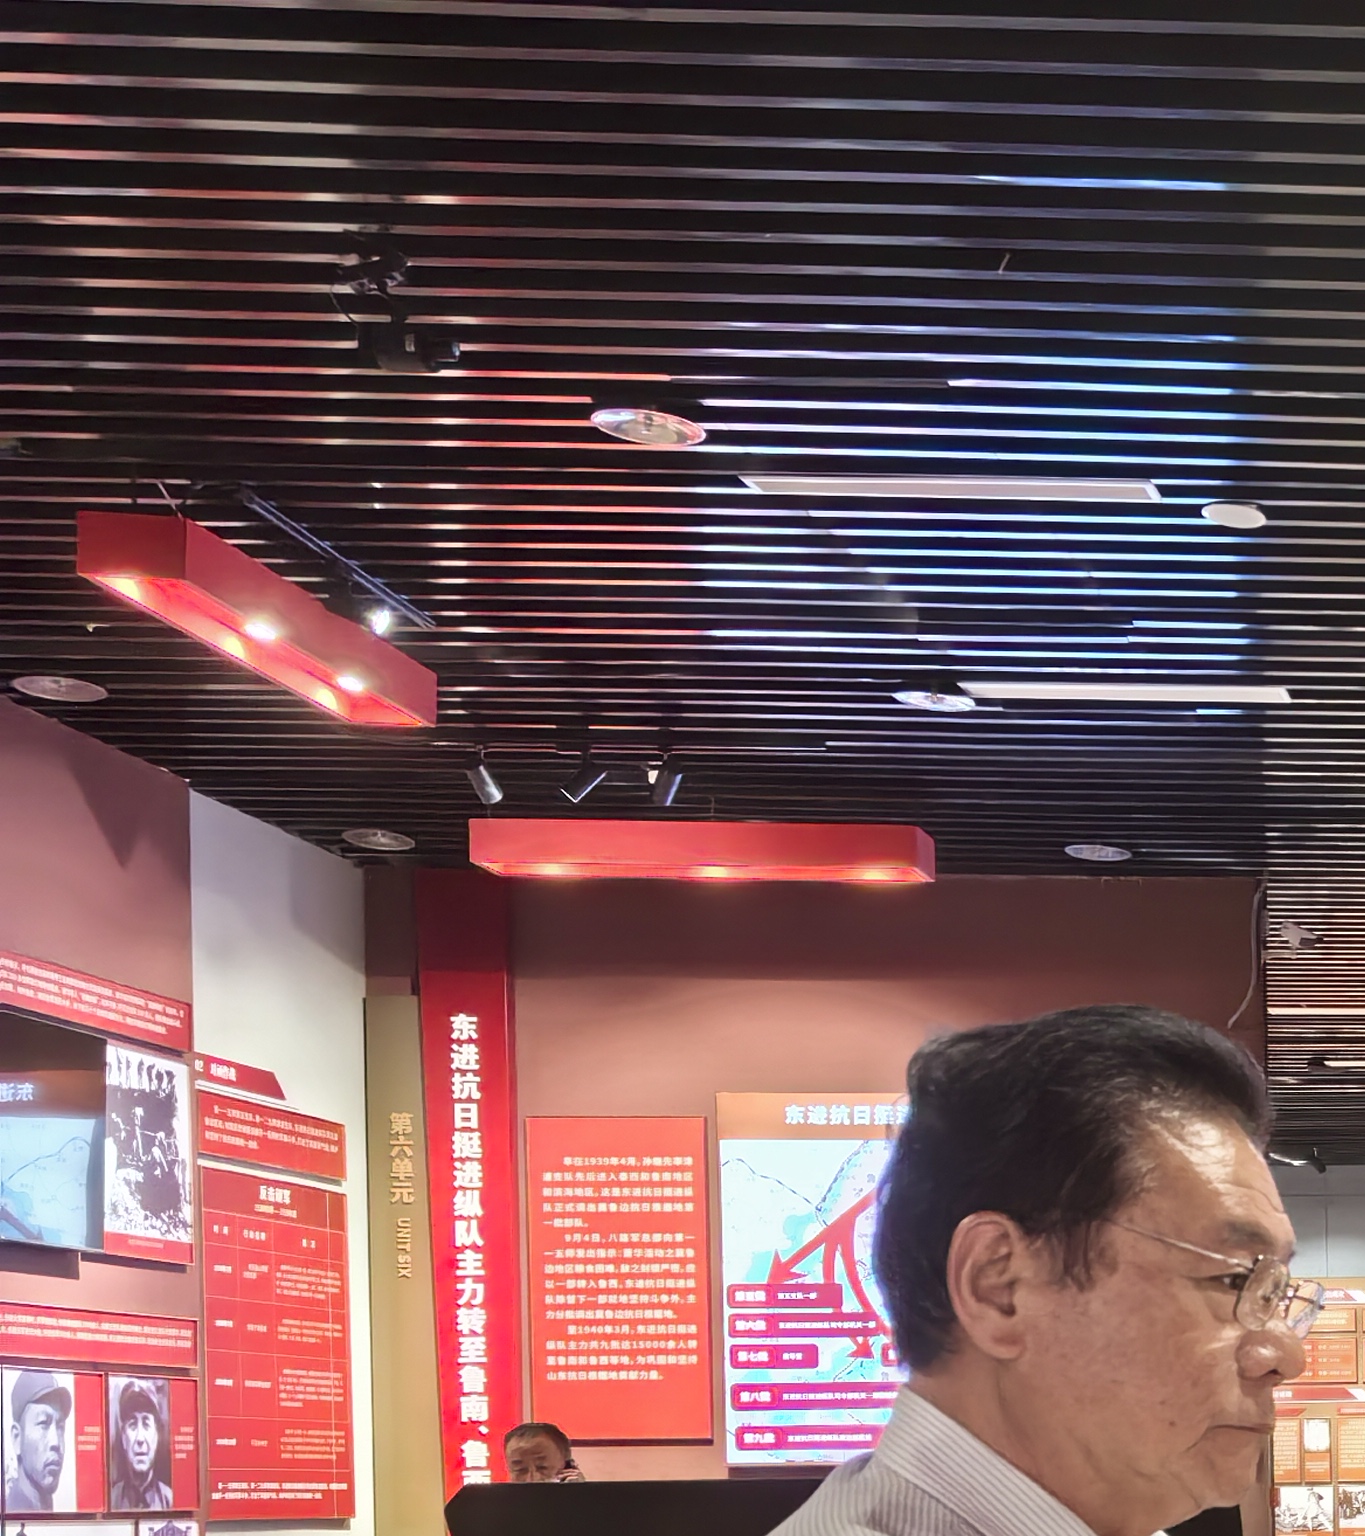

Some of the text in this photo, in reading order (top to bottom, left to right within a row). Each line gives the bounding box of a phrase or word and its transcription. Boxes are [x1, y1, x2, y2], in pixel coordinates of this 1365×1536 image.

[389, 1112, 415, 1205] 第六单元
[397, 1217, 412, 1279] UNIT SIX
